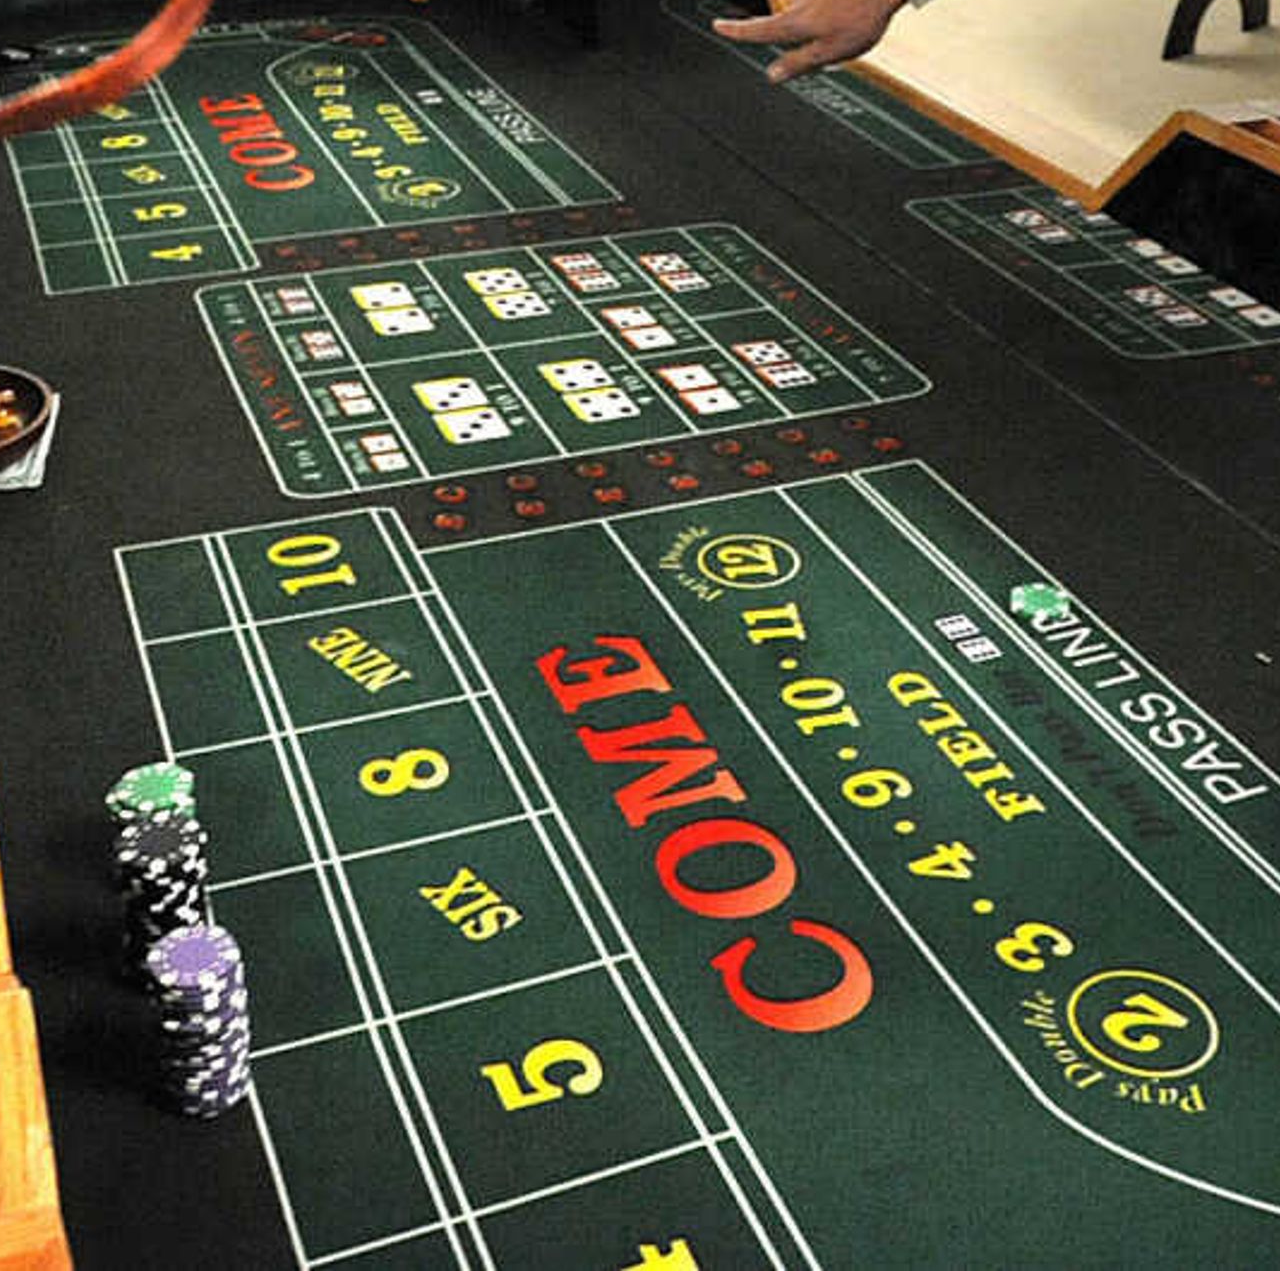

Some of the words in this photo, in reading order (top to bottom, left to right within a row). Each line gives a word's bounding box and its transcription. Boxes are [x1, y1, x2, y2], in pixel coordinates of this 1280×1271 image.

[101, 134, 149, 150] 8
[199, 94, 314, 191] COME
[133, 203, 187, 222] 5
[149, 244, 203, 261] 4
[267, 535, 356, 595] 10
[717, 543, 778, 579] 12
[741, 601, 806, 645] 11
[307, 627, 412, 692] NINE
[780, 677, 860, 735] 10
[359, 747, 449, 796] 8
[887, 671, 1046, 821] FIELD
[1120, 692, 1269, 803] PASS
[841, 769, 913, 809] 9
[536, 635, 874, 1033] COME
[900, 839, 974, 881] 4
[421, 867, 521, 941] SIX
[995, 922, 1074, 972] 3
[1022, 989, 1106, 1090] Double
[1102, 991, 1190, 1052] 2
[481, 1040, 604, 1111] 5
[1115, 1076, 1207, 1114] Pays
